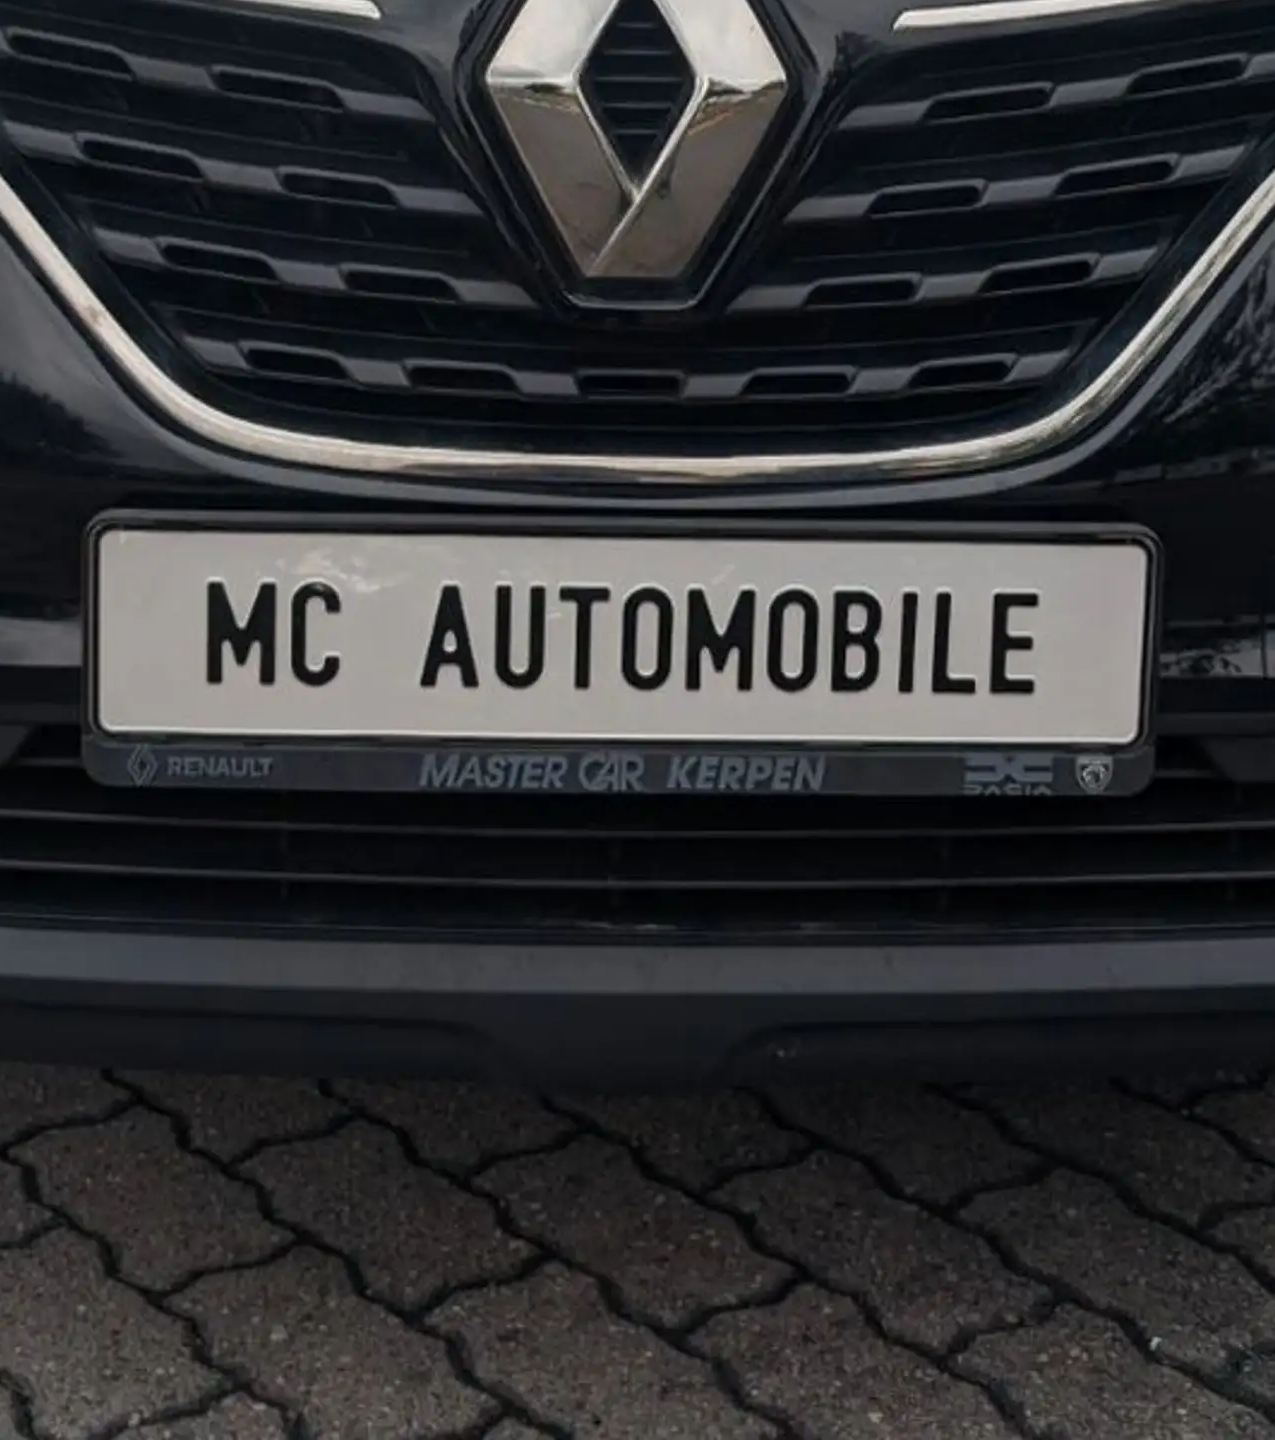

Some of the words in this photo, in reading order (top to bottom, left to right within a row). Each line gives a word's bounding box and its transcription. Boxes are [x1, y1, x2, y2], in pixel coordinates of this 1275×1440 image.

[205, 580, 343, 687] MC
[420, 582, 1042, 697] AUTOMOBILE
[167, 755, 275, 778] RENAULT
[419, 752, 569, 789] MASTER
[578, 749, 646, 792] CAR
[666, 753, 827, 792] KERPEN
